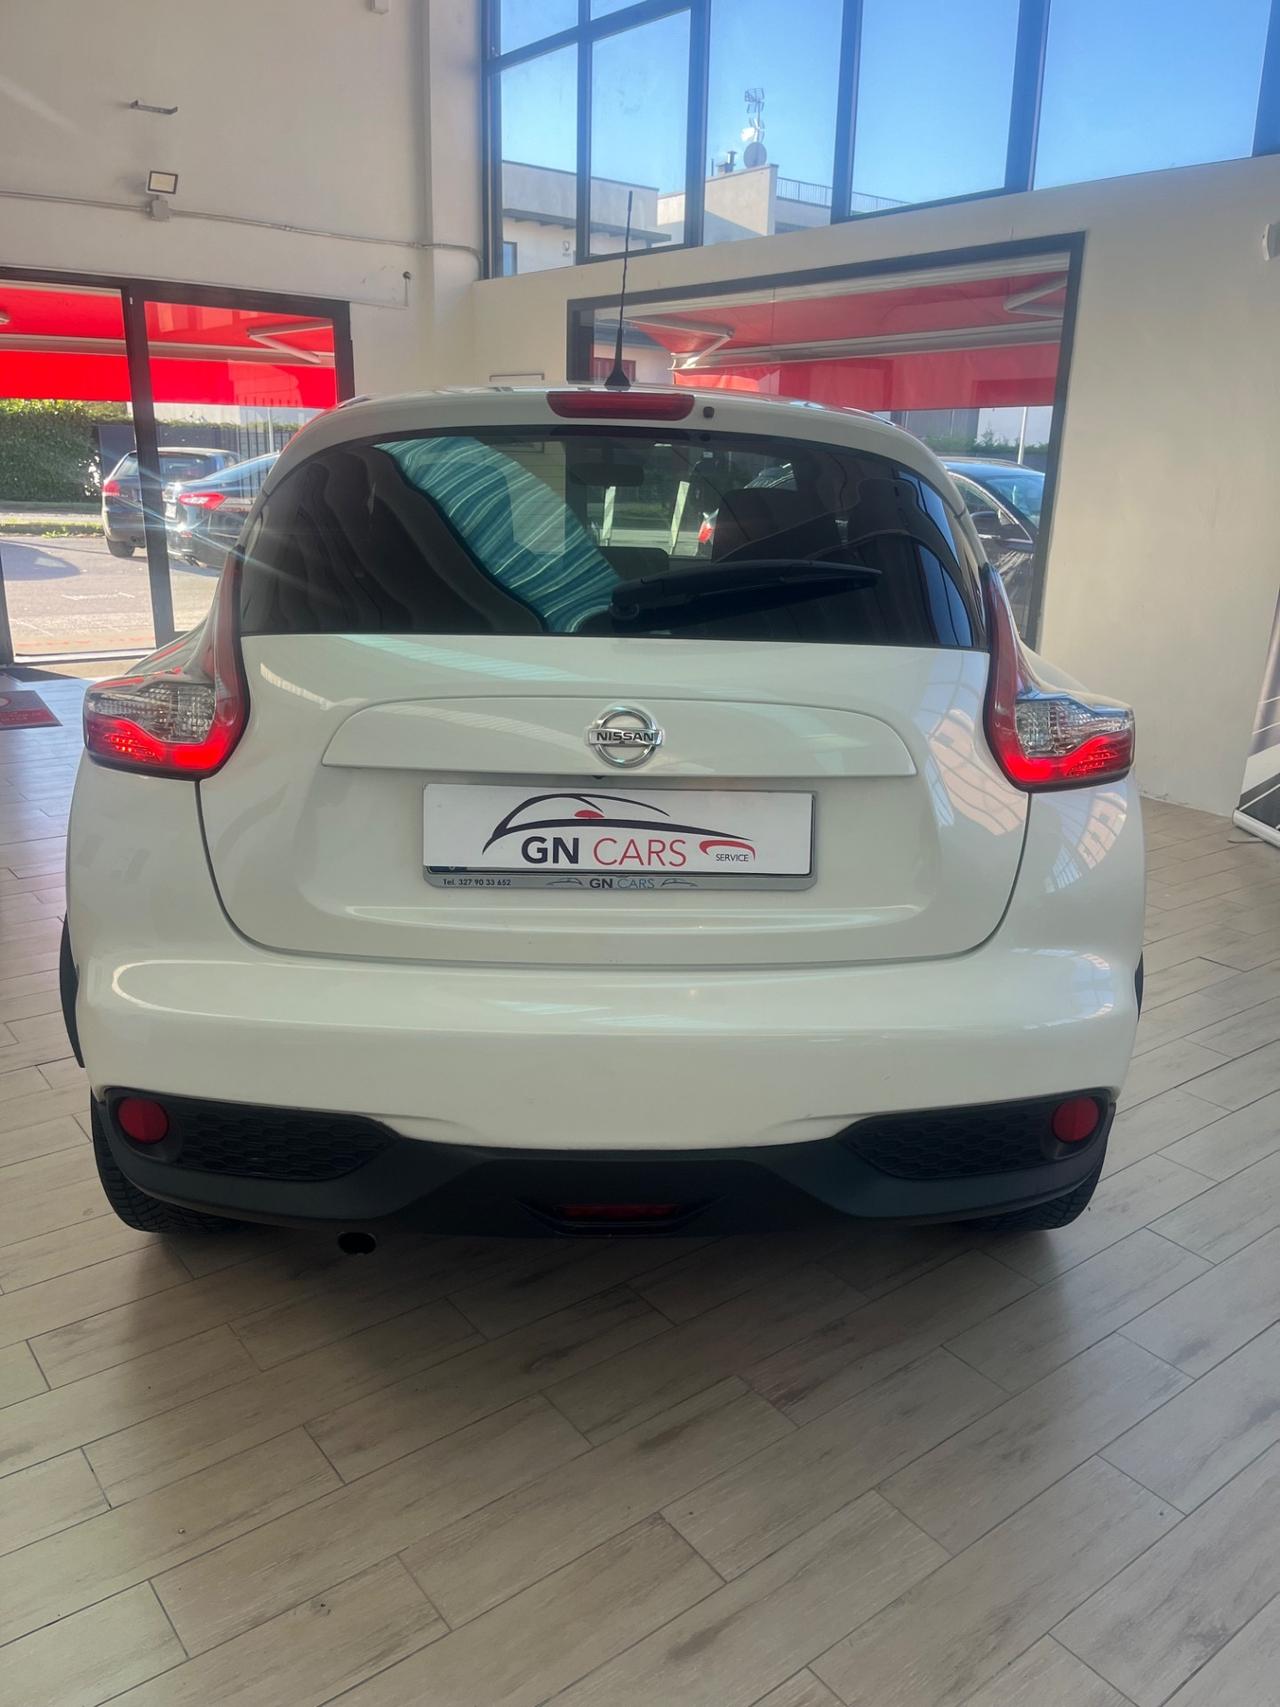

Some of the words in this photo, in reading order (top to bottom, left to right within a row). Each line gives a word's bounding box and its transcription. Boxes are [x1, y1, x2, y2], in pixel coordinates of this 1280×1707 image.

[597, 731, 654, 742] NISSAN
[521, 836, 579, 865] GN
[593, 838, 687, 868] CARS
[715, 853, 749, 863] SERVICE
[458, 878, 472, 886] 327
[474, 878, 484, 886] 90
[486, 878, 495, 886] 33
[497, 879, 512, 887] 652
[589, 878, 613, 889] GN
[617, 878, 655, 889] CARS
